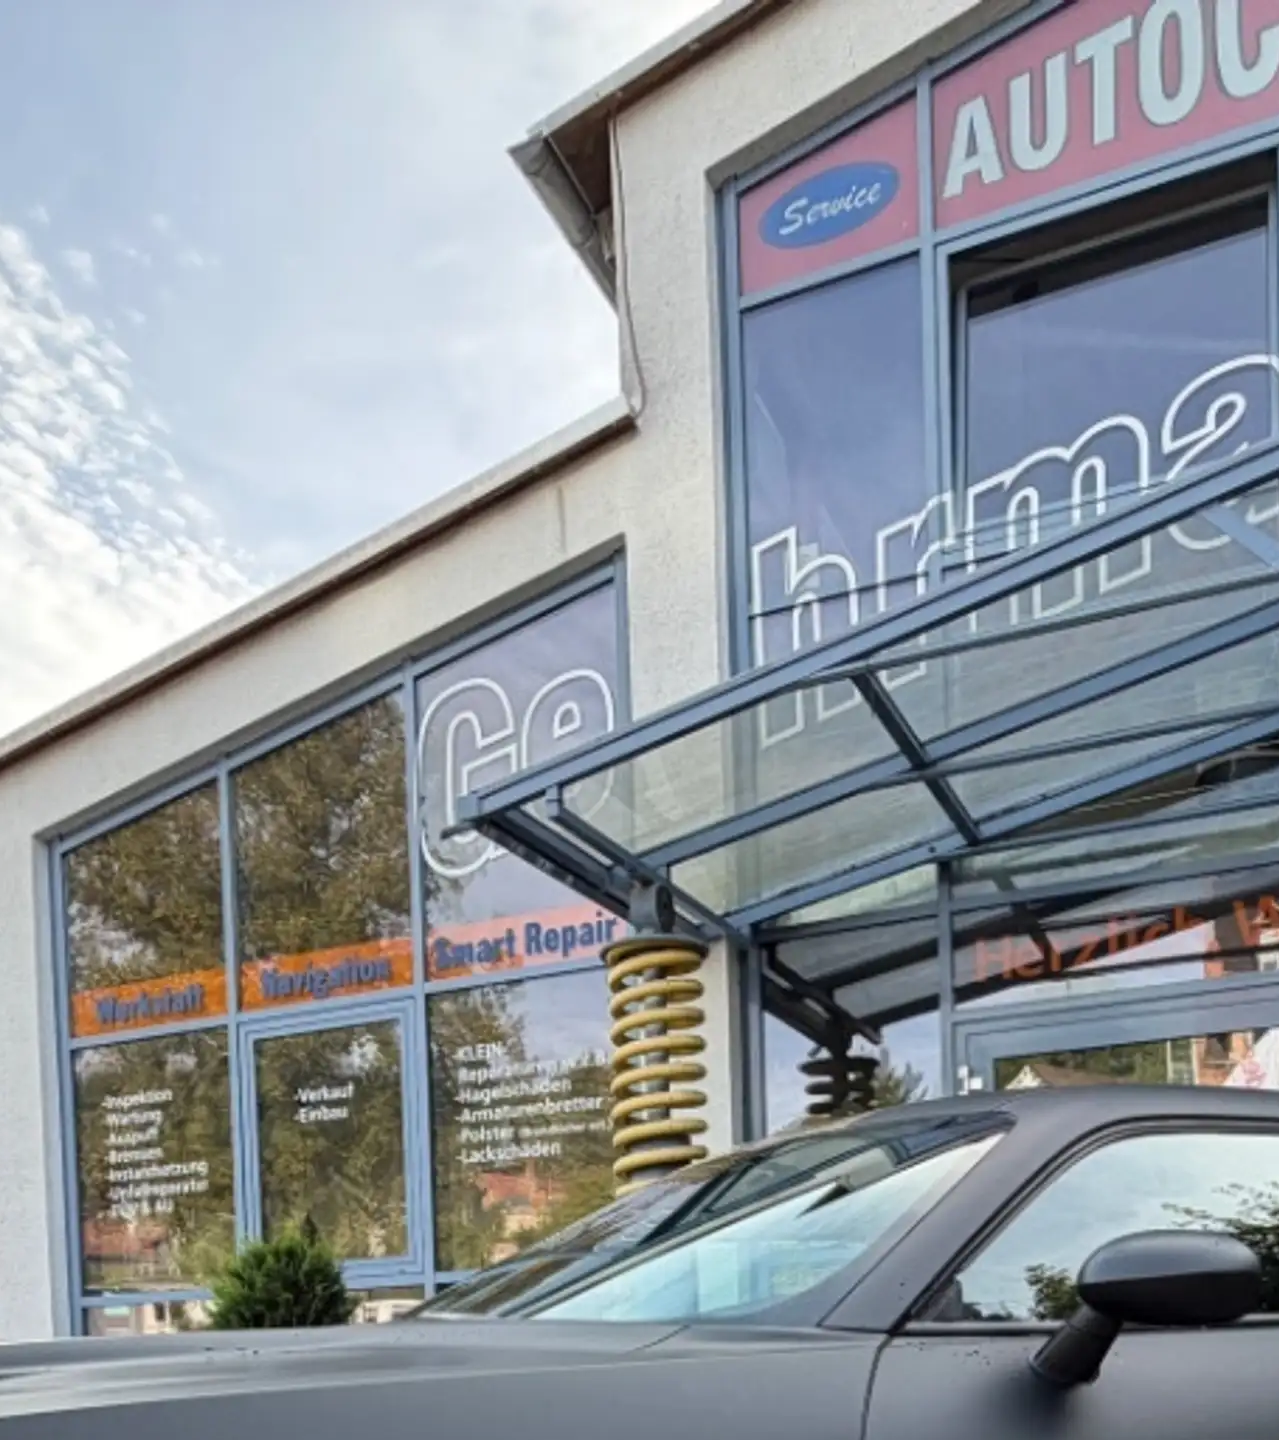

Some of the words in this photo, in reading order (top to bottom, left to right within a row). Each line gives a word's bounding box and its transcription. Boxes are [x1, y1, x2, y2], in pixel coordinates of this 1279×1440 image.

[778, 181, 882, 236] Service
[434, 927, 517, 970] Smart
[524, 910, 618, 958] Repair
[257, 954, 394, 1000] Navigation
[96, 981, 205, 1026] Werkstatt
